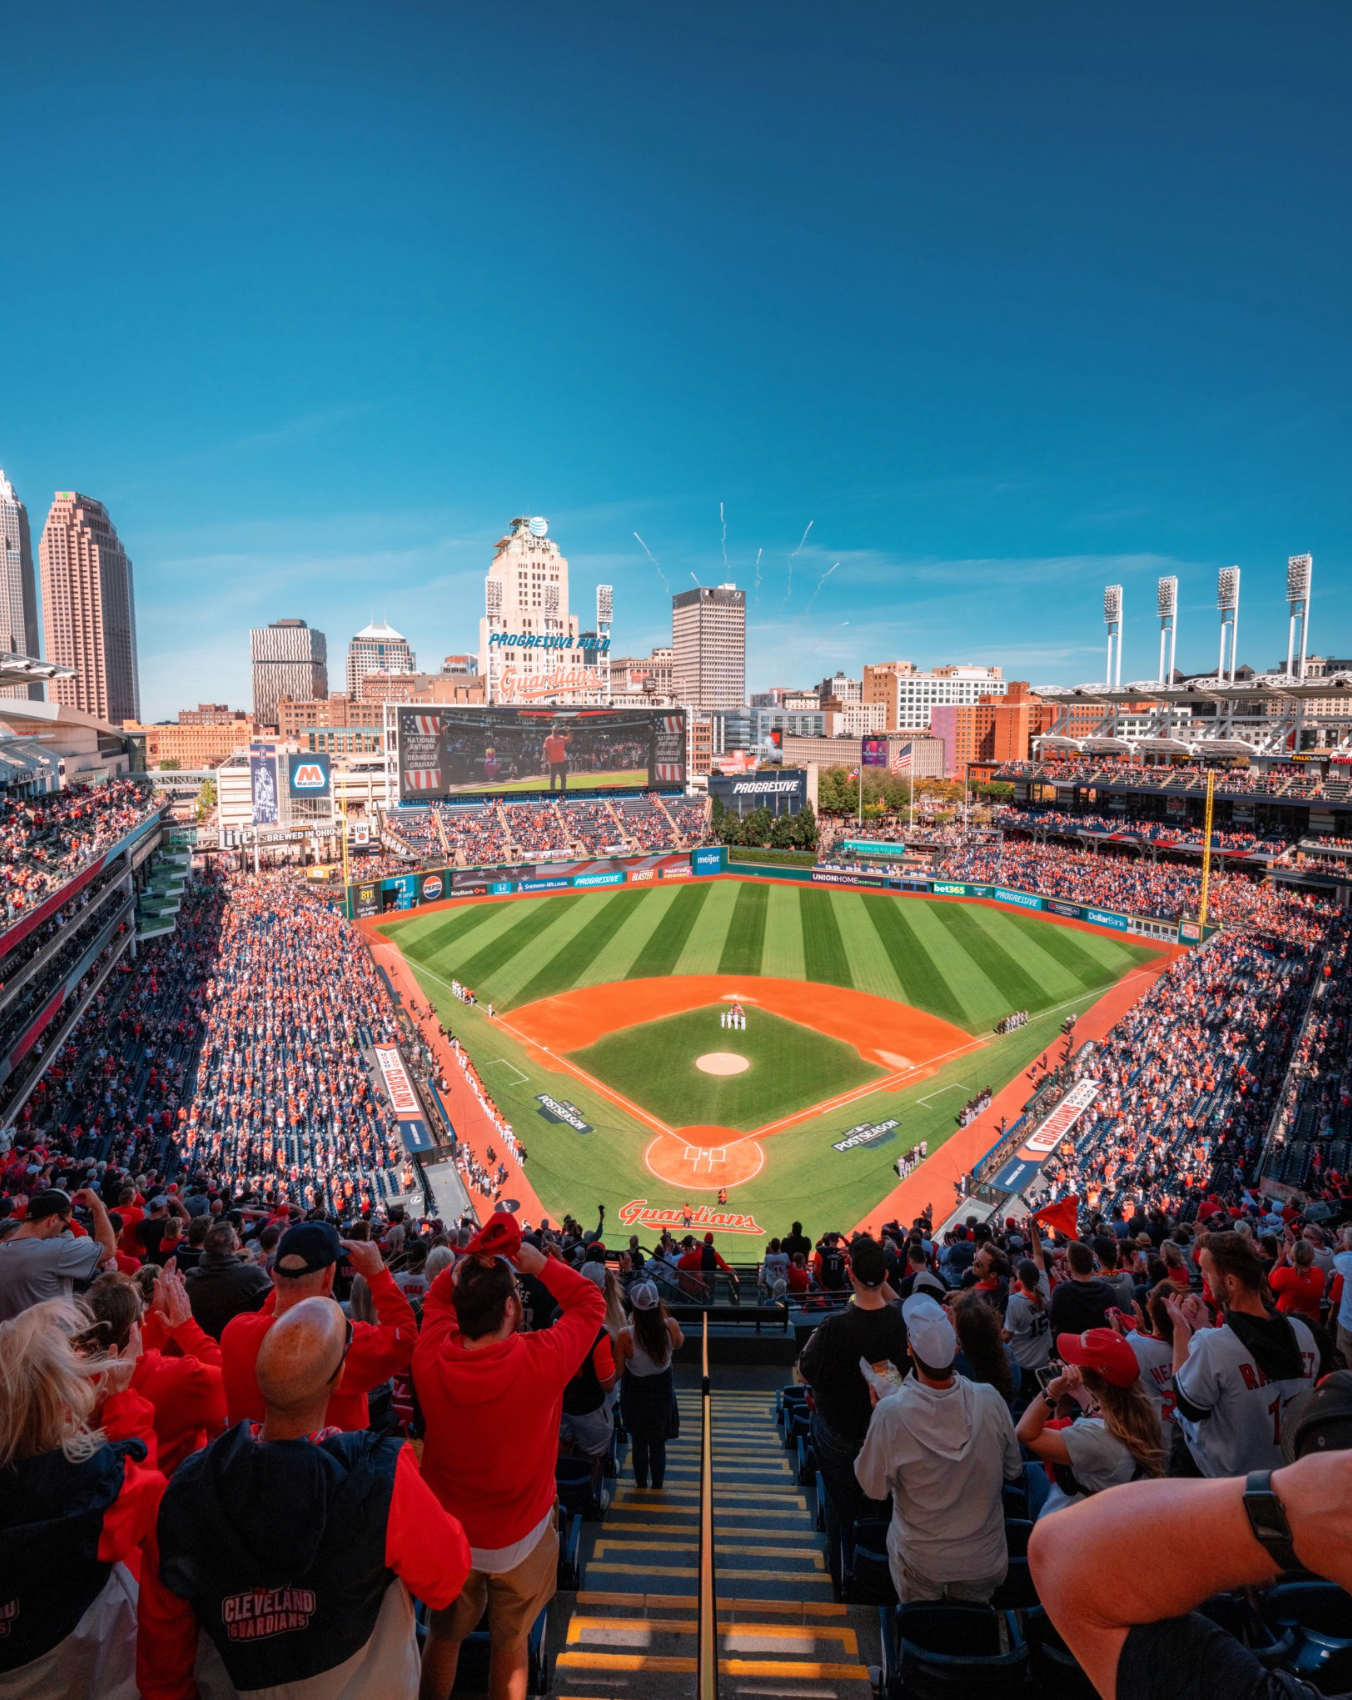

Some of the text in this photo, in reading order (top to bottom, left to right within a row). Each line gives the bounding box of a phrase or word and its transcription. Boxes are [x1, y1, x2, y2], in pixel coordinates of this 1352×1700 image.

[488, 633, 611, 650] PROGRESSIVE FIELD
[500, 665, 604, 699] Guardians
[298, 767, 322, 781] M
[733, 781, 799, 794] PROGRESSIVE
[217, 829, 254, 851] Lite
[267, 828, 335, 842] BREWED IN OHIO
[697, 854, 719, 865] meijer
[575, 874, 620, 886] PROGRESSIVE
[631, 871, 654, 881] BLASTER
[361, 889, 372, 900] 811
[424, 884, 442, 892] PEPSI
[933, 884, 965, 894] bet365
[995, 891, 1038, 907] PROGRESSIVE
[1146, 932, 1172, 943] CLIFFS
[385, 1068, 415, 1108] CLEVELAND
[537, 1095, 588, 1130] POSTSEASON
[1033, 1103, 1082, 1146] GUARDIANS
[833, 1119, 900, 1152] POSTSEASON
[619, 1199, 760, 1229] Guardians
[224, 1590, 313, 1623] CLEVELAND
[230, 1612, 306, 1638] GUARDIANS
